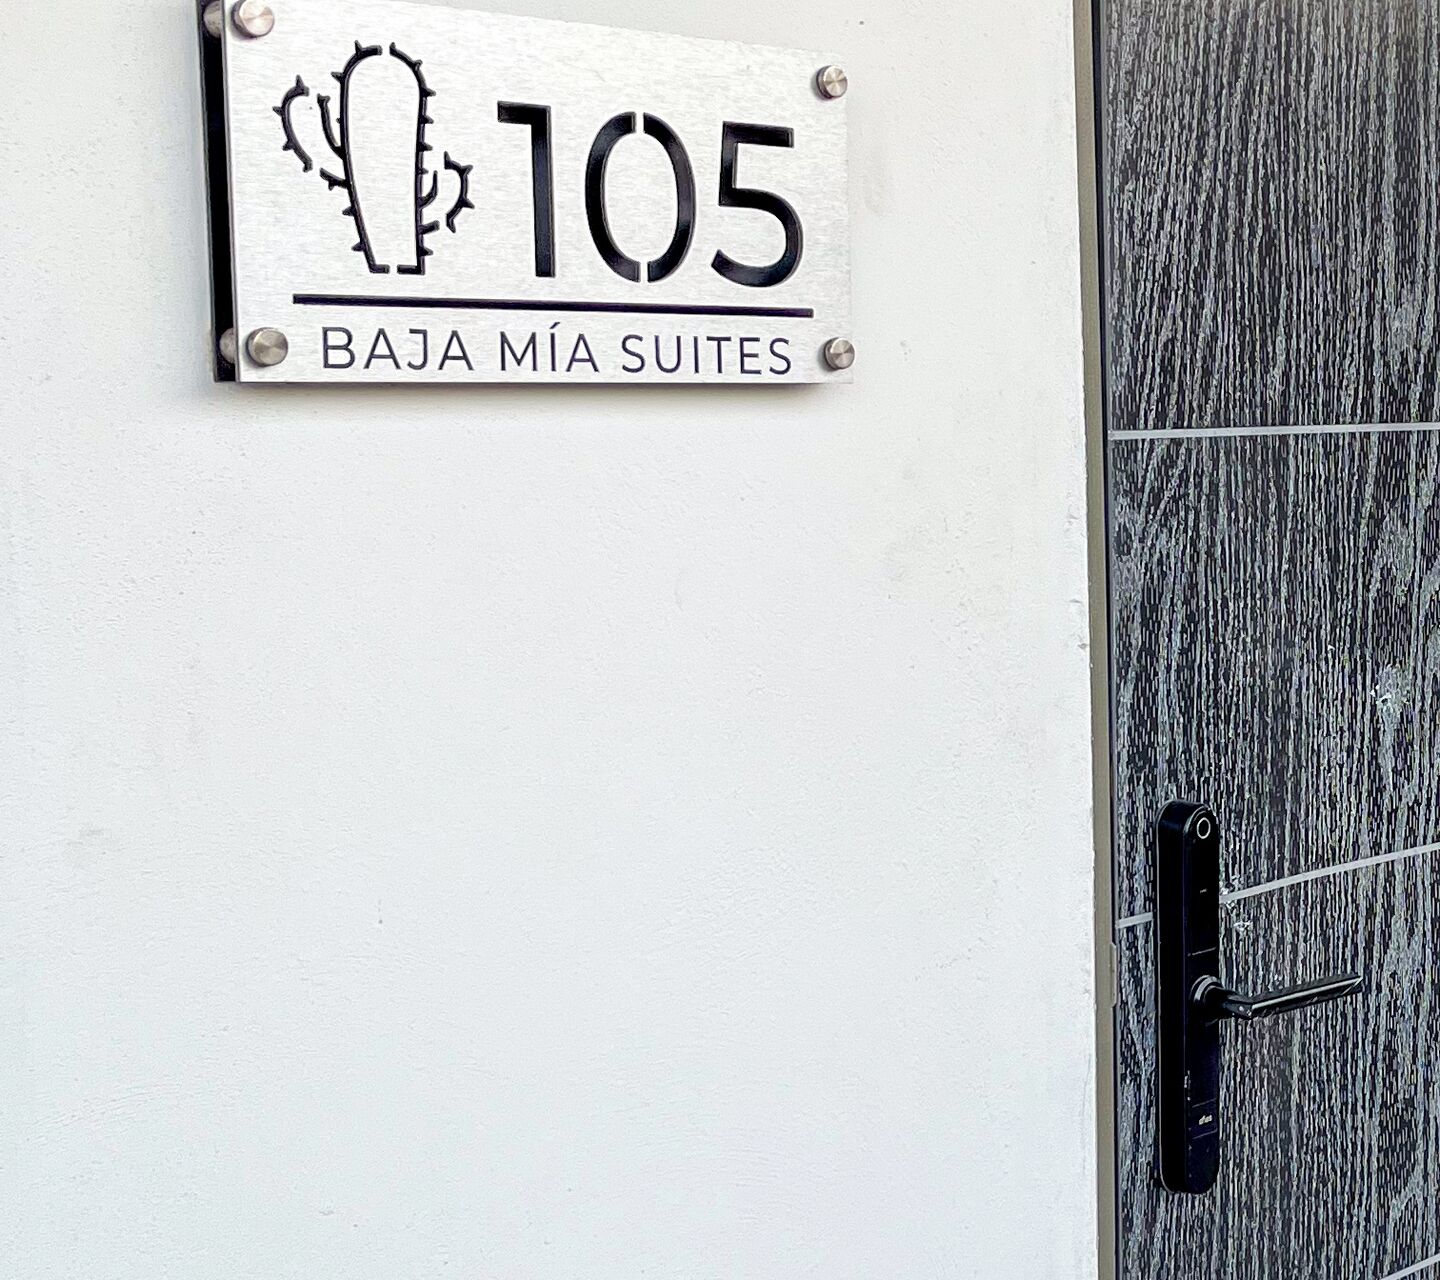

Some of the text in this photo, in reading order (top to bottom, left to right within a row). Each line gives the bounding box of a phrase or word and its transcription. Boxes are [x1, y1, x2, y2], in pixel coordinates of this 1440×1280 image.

[496, 100, 804, 288] 105
[322, 321, 792, 375] BAJA MÍA SUITES
